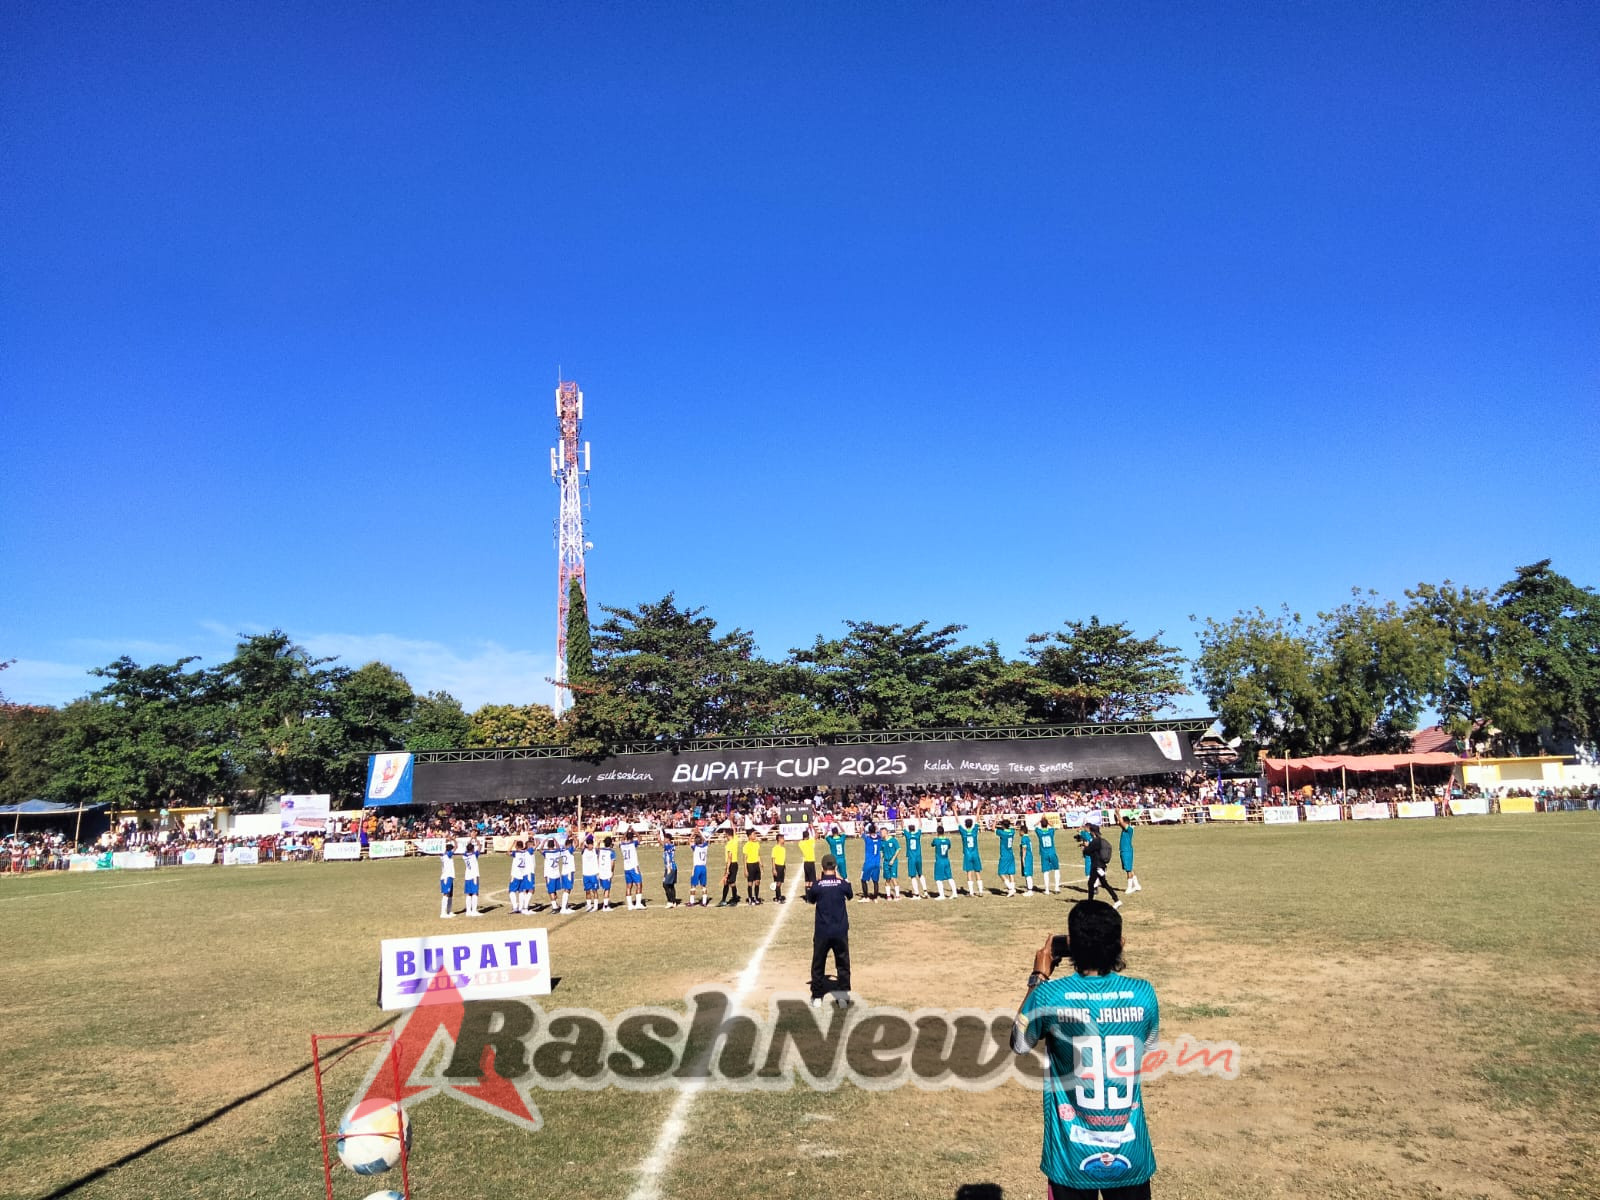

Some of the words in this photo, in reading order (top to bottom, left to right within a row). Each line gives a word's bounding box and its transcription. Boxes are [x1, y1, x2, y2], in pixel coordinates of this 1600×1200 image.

[561, 774, 591, 785] Mari
[672, 761, 763, 783] BUPATI
[776, 757, 829, 778] CUP
[838, 755, 908, 776] 2025
[960, 760, 1000, 775] Menang
[395, 939, 539, 977] BUPATI
[1095, 1006, 1145, 1024] JAUHAR
[1072, 1034, 1135, 1110] 99
